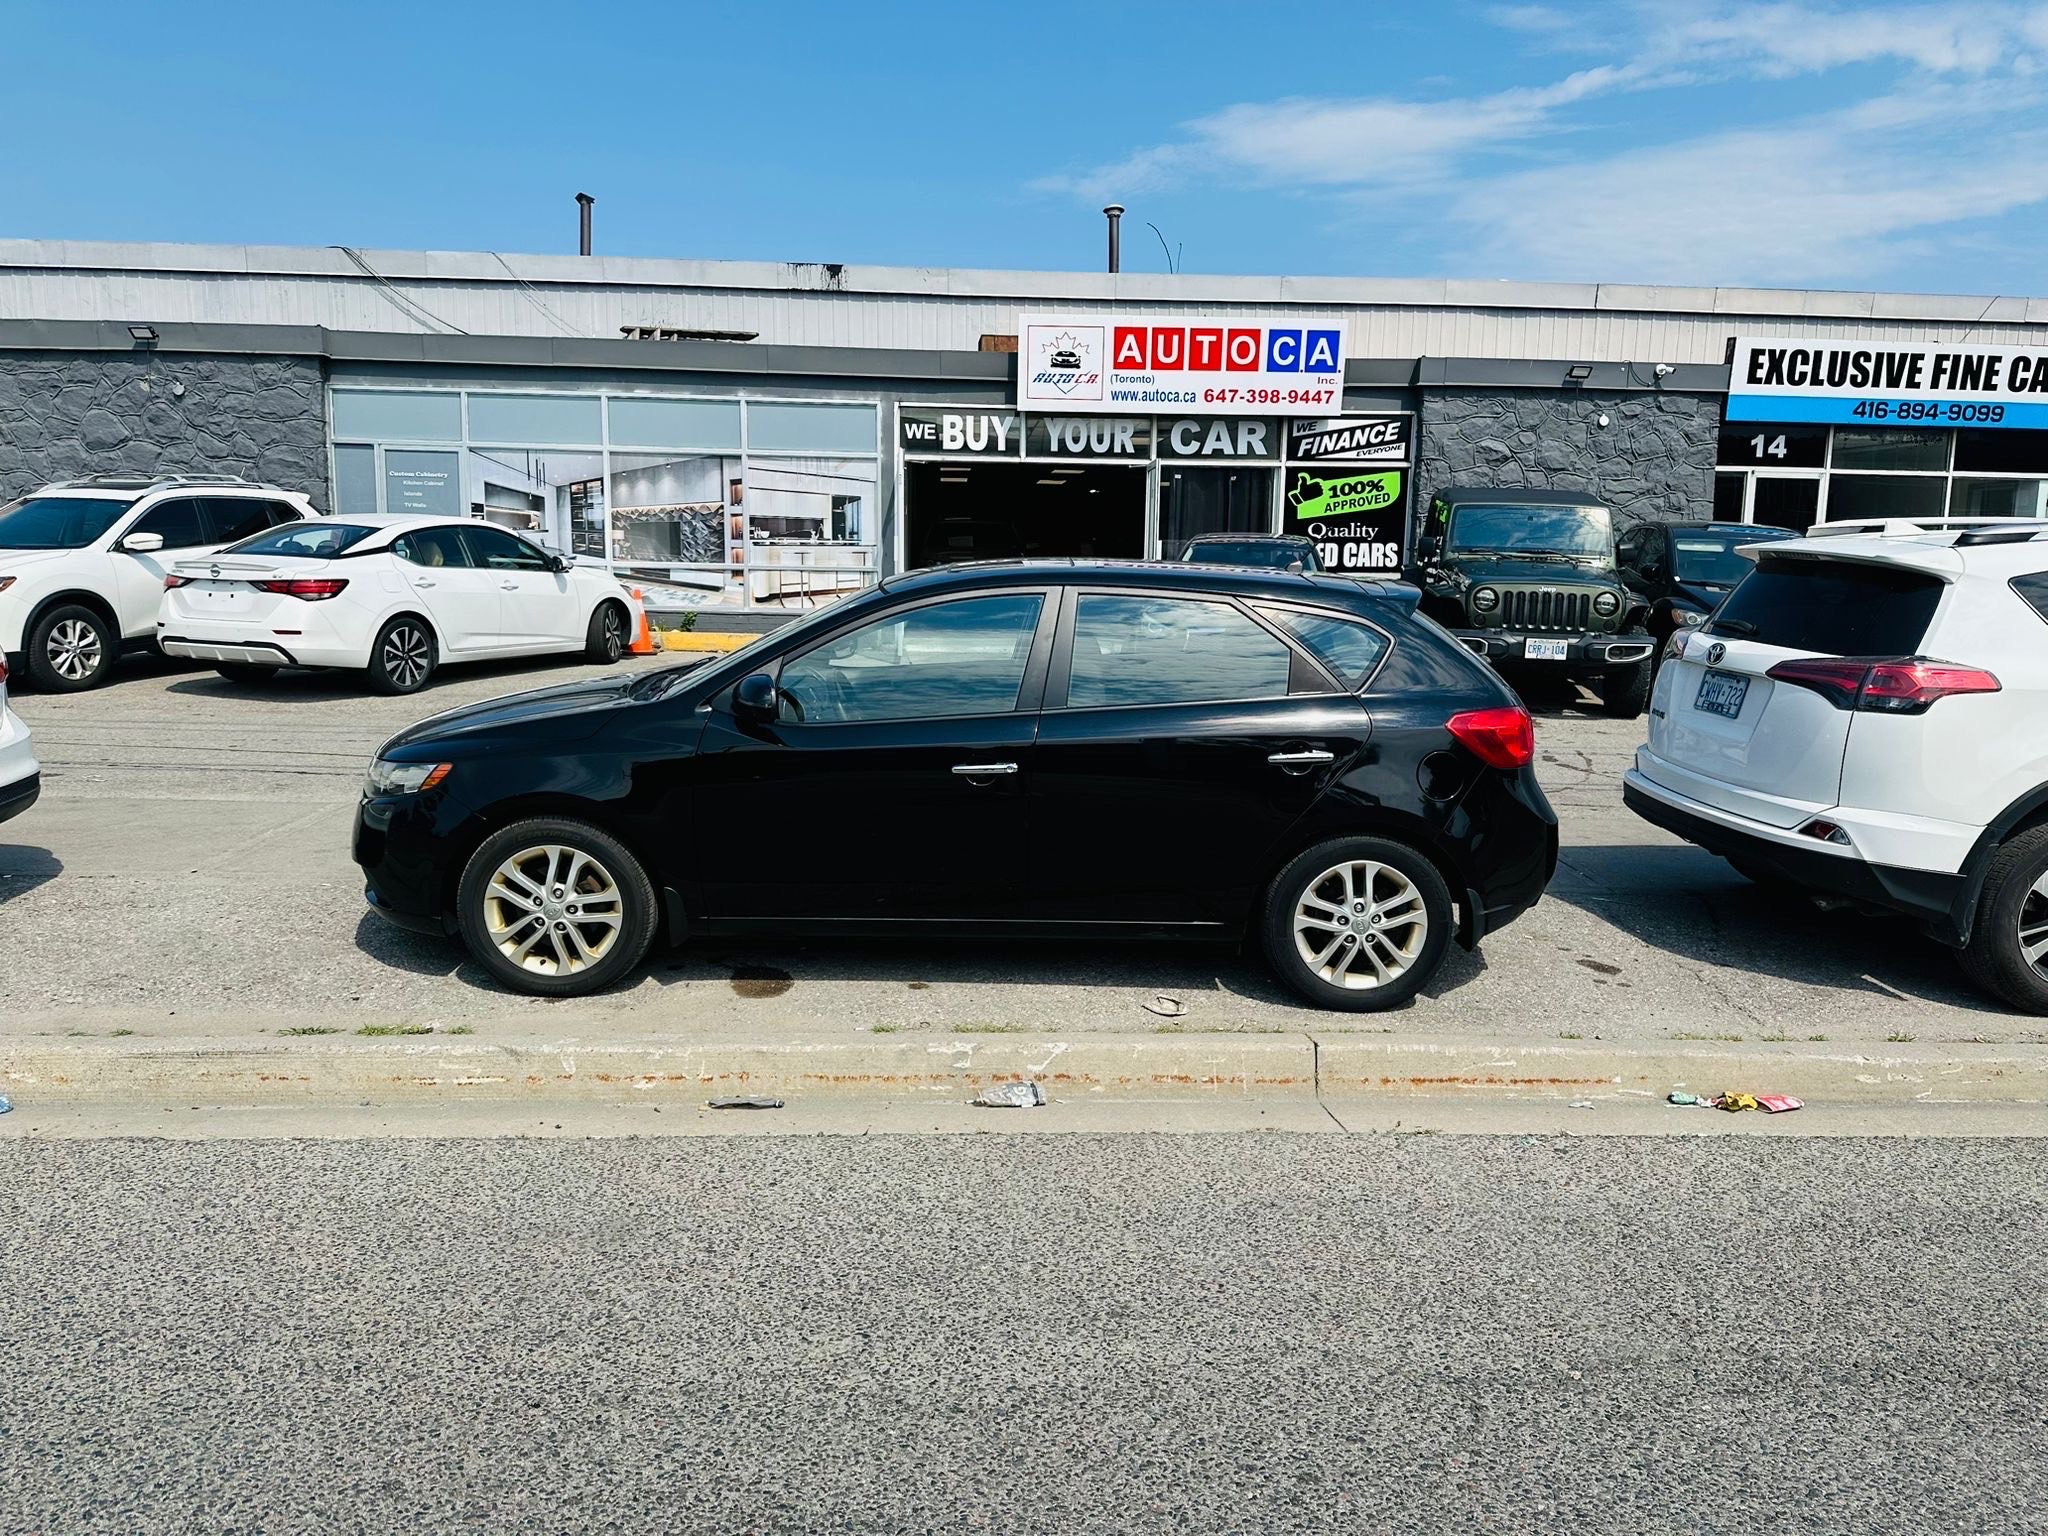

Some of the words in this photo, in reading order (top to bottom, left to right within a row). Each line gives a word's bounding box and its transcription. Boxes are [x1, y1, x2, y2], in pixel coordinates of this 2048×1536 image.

[1117, 334, 1256, 366] AUTO
[1109, 374, 1156, 385] (Toronto)
[1317, 376, 1338, 385] Inc.
[1746, 347, 1926, 390] EXCLUSIVE
[1930, 354, 2003, 391] FINE
[2007, 355, 2048, 393] CA
[1110, 388, 1196, 403] www.autoca.ca
[1203, 388, 1335, 405] 647-398-9447
[1852, 400, 2005, 423] 416-894-9099
[904, 423, 937, 440] WE
[942, 414, 1015, 452] BUY
[1043, 417, 1136, 454] YOUR
[1169, 419, 1268, 456] CAR
[1296, 421, 1318, 433] WE
[1297, 421, 1402, 458] FINANCE
[1356, 443, 1403, 457] EVERYONE
[1750, 433, 1787, 459] 14
[1328, 478, 1385, 499] 100%
[1324, 491, 1391, 514] APPROVED
[1307, 522, 1379, 540] Quality
[1315, 542, 1338, 568] ED
[1342, 542, 1399, 568] CARS
